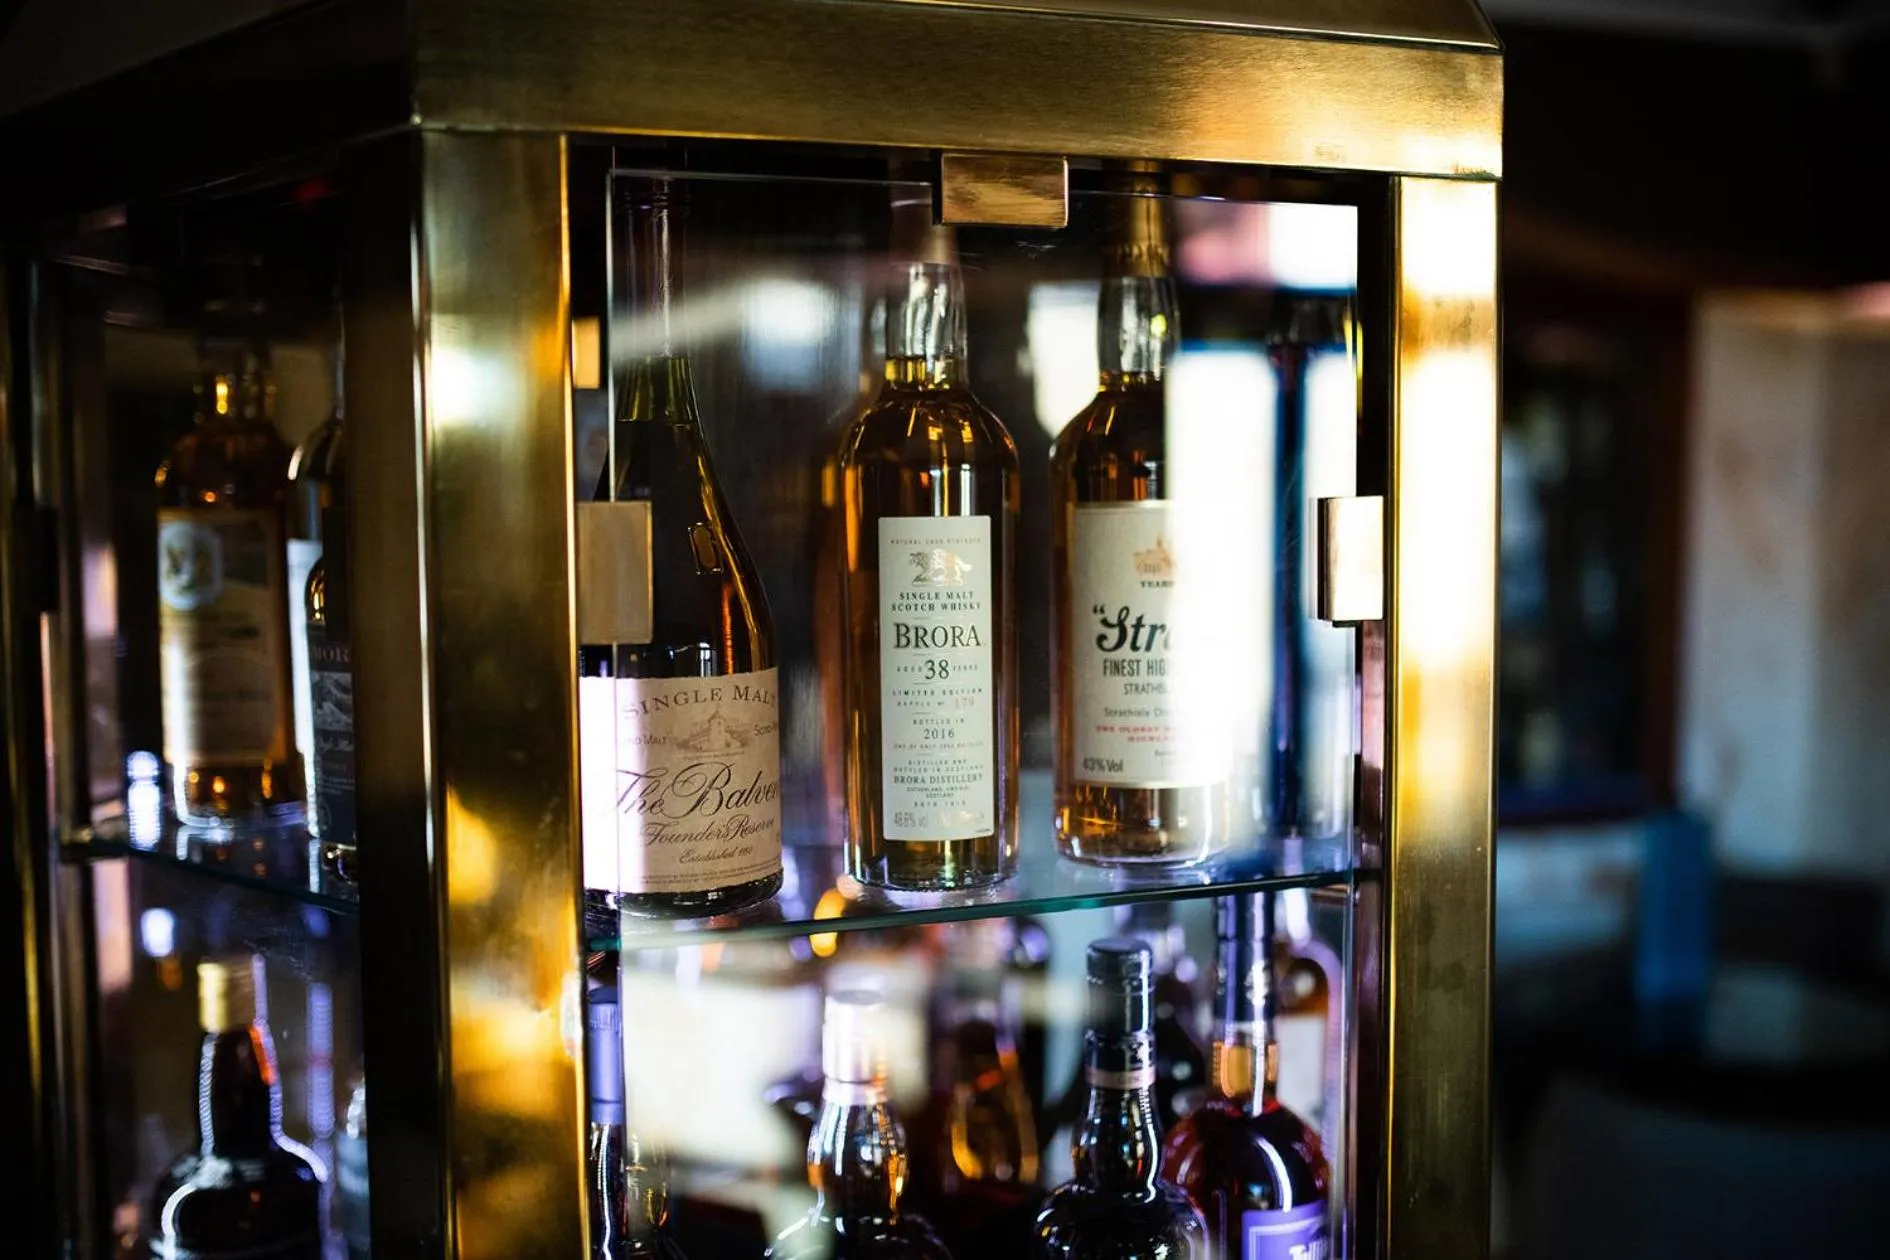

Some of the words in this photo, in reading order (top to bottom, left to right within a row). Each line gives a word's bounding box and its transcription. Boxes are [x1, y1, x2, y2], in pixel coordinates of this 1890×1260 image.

[899, 591, 940, 600] SINGLE
[946, 591, 975, 600] MALT
[891, 602, 935, 612] SCOTCH
[941, 602, 982, 611] WHISKY
[894, 622, 981, 649] BRORA
[925, 659, 950, 680] 38
[1103, 659, 1141, 677] FINEST
[924, 728, 955, 740] 2016
